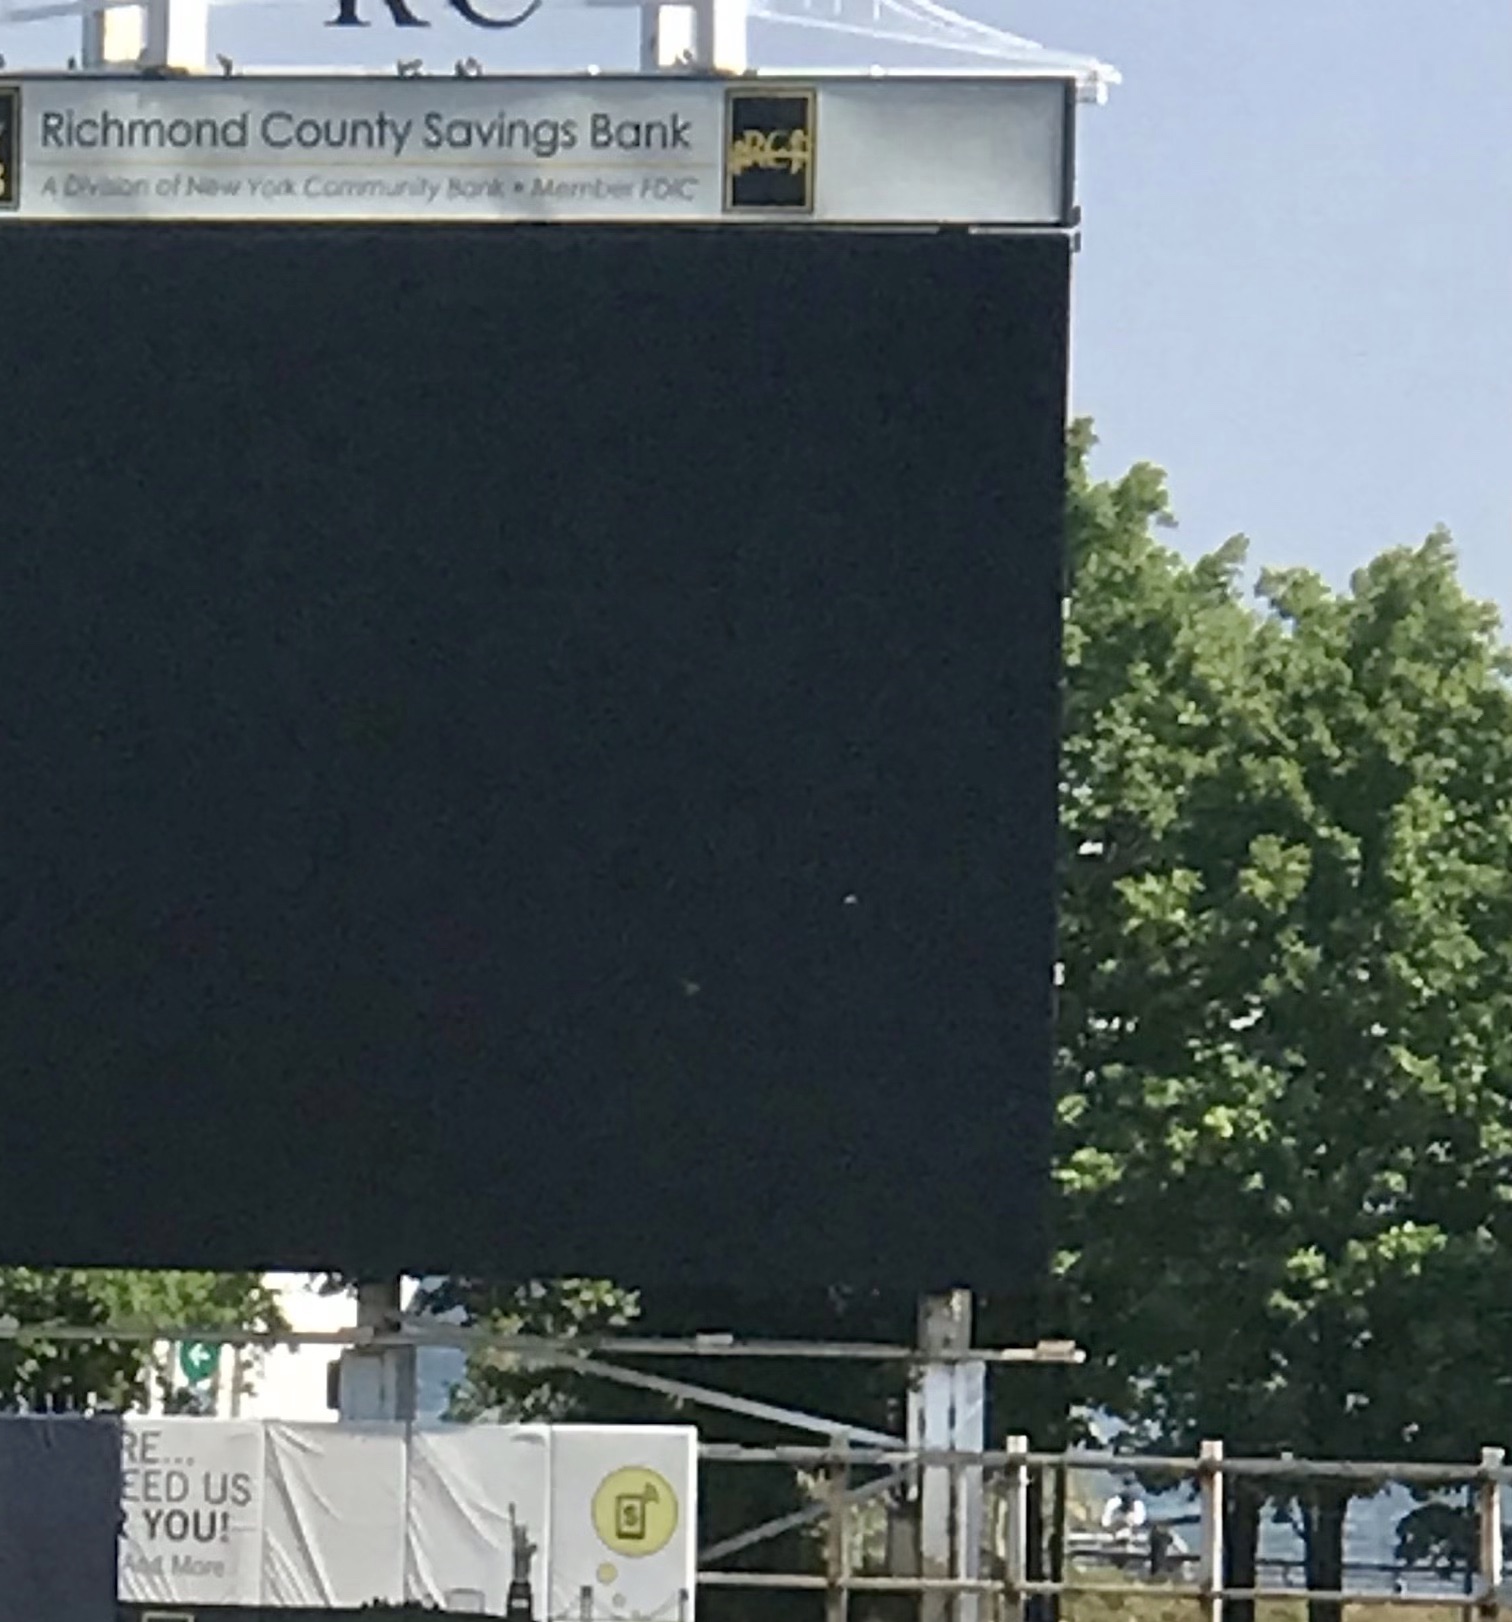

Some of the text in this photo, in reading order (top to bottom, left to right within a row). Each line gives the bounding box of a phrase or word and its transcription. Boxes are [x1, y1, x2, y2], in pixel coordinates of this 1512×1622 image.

[41, 109, 692, 158] Richmond County Savings Bank
[40, 173, 700, 204] A Division of New York Community Bank Member FDIC
[203, 1471, 252, 1508] US
[142, 1508, 230, 1544] YOU!
